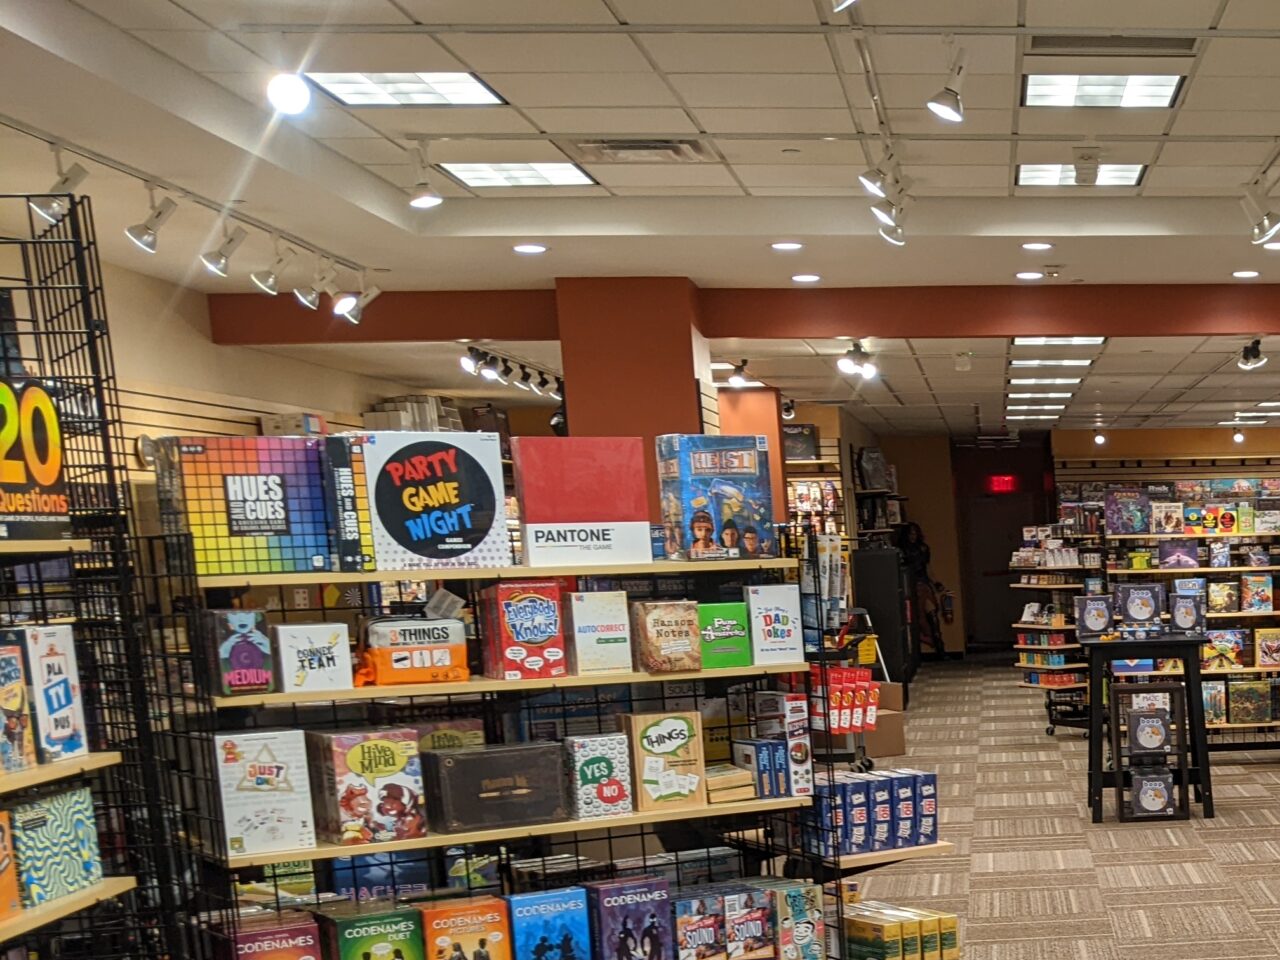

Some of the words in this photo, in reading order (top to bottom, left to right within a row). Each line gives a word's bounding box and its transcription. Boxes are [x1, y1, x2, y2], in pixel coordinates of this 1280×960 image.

[385, 448, 458, 486] PARTY
[692, 450, 757, 472] HEIST
[226, 475, 284, 501] HUES
[339, 467, 353, 498] HUES
[402, 482, 459, 512] GAME
[229, 501, 245, 520] AND
[245, 500, 286, 520] CUES
[343, 511, 359, 541] CUES
[405, 503, 474, 542] NIGHT
[534, 528, 613, 544] PANTONE
[593, 543, 612, 551] GAME
[577, 623, 627, 634] AUTOCORRECT
[652, 617, 694, 628] Ransom
[762, 613, 790, 627] DAD
[400, 626, 450, 642] THINGS
[655, 628, 691, 639] Notes
[298, 655, 337, 672] TEAM
[224, 669, 272, 686] MEDIUM
[583, 763, 610, 780] YES
[602, 784, 619, 798] NO
[603, 889, 668, 908] CODENAMES
[515, 899, 585, 918] CODENAMES
[344, 920, 415, 940] CODENAMES
[432, 913, 501, 930] CODENAMES
[735, 920, 763, 941] SOUND
[237, 935, 315, 955] CODENAMES
[387, 931, 411, 942] DUET
[686, 927, 715, 948] SOUND
